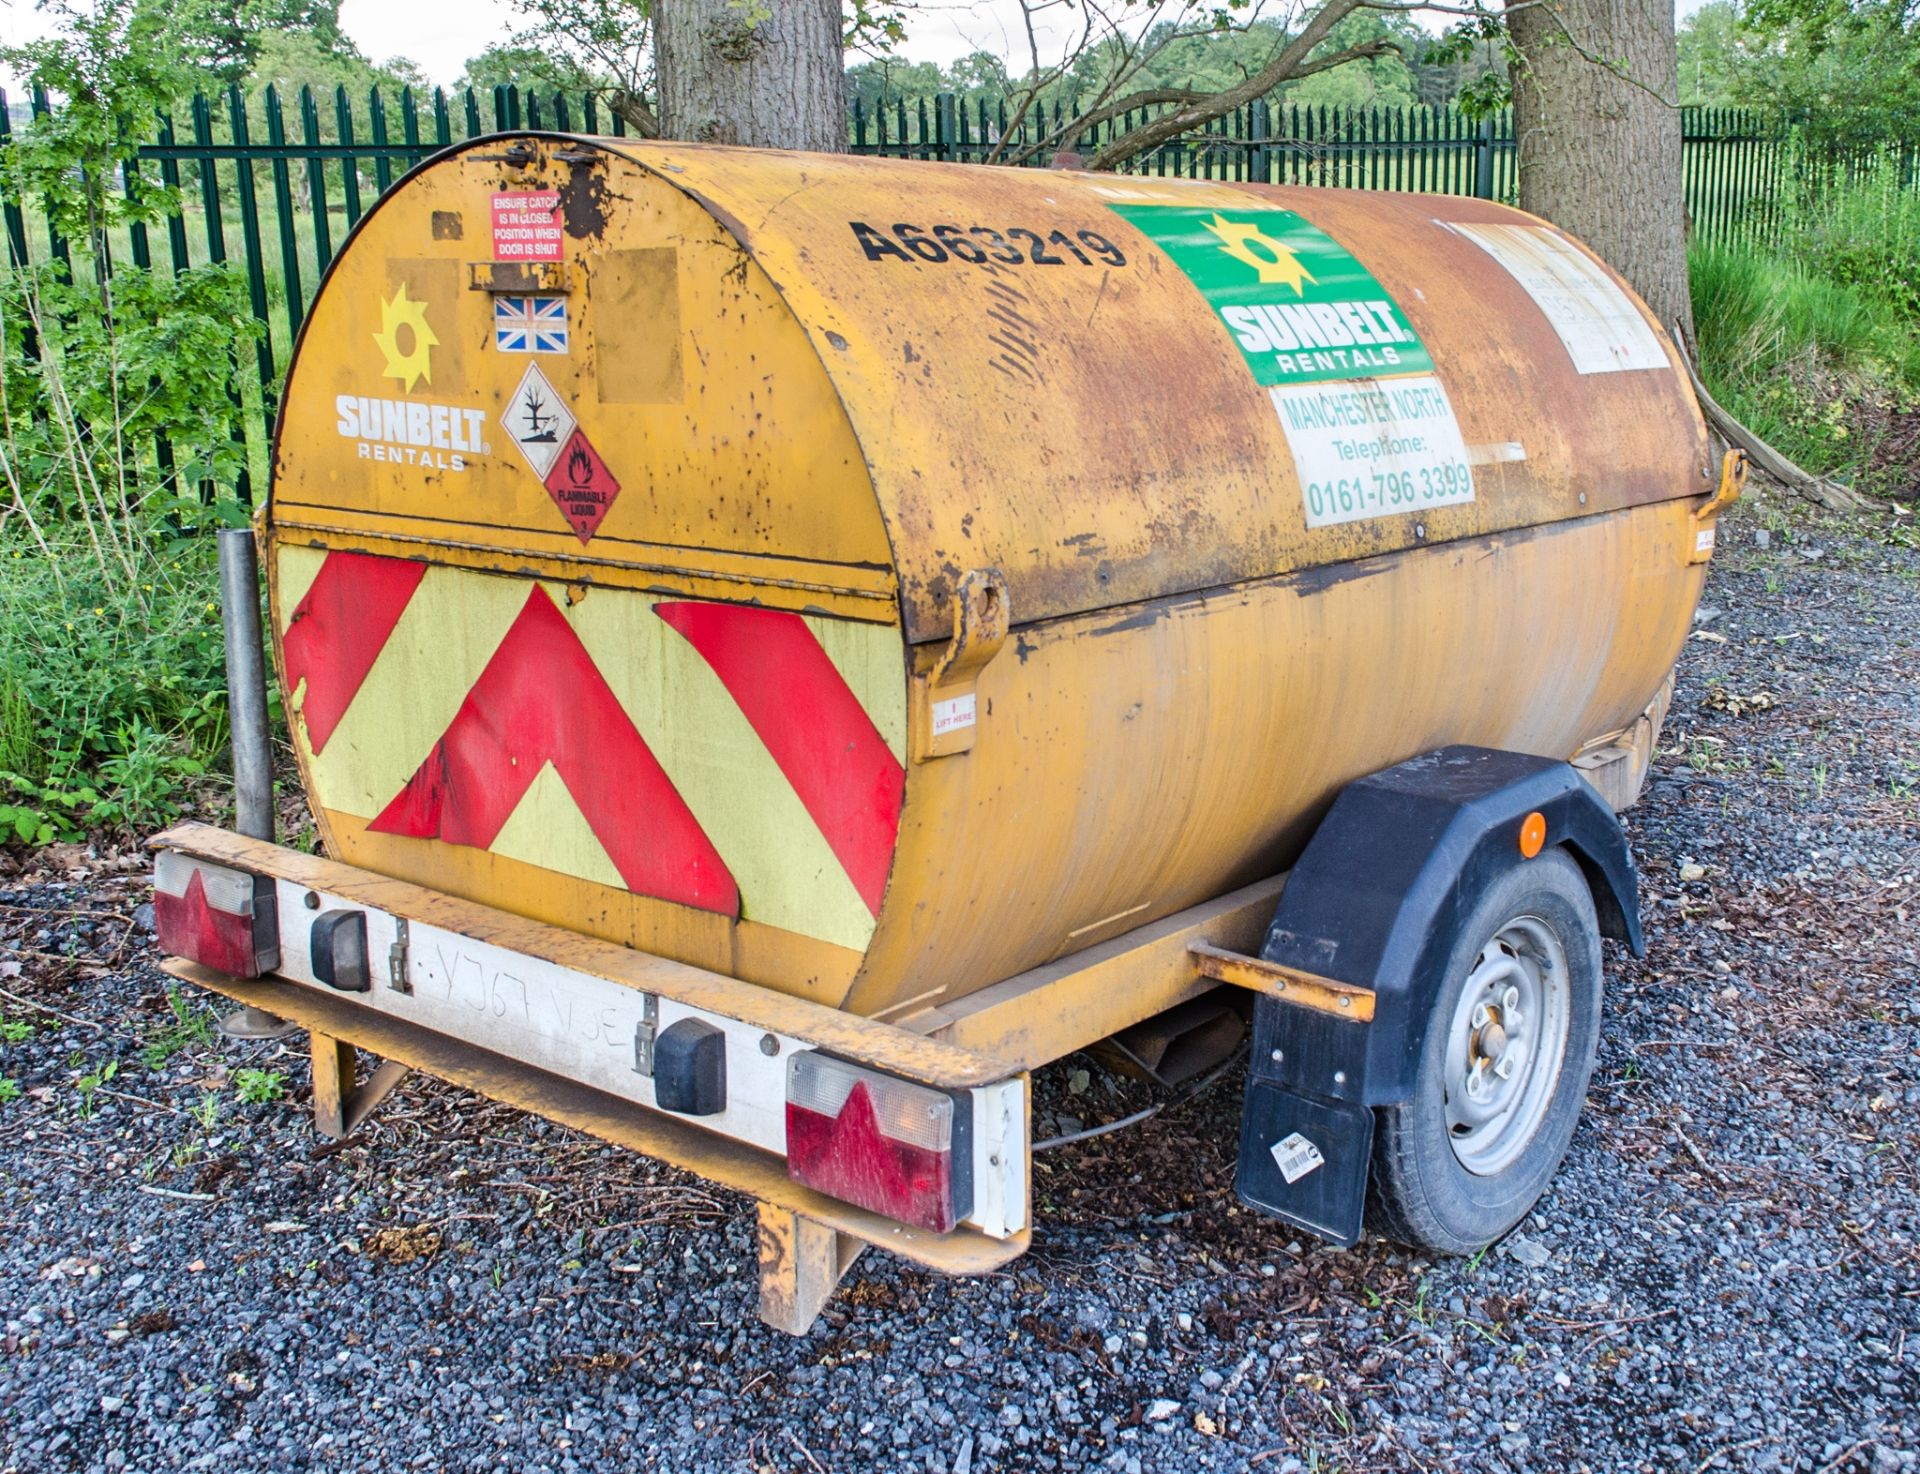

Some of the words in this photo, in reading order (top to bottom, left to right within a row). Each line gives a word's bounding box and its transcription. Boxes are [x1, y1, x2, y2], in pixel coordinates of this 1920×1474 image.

[494, 197, 528, 209] ENSURE
[528, 196, 558, 209] CATCH
[499, 213, 508, 224] IS
[509, 213, 519, 224] IN
[520, 212, 554, 224] CLOSED
[494, 228, 534, 240] POSITION
[534, 228, 561, 240] WHEN
[848, 221, 1127, 267] A663219
[498, 243, 524, 255] DOOR
[525, 243, 534, 255] IS
[534, 242, 558, 255] SHUT
[1220, 300, 1408, 353] SUNBELT
[1275, 347, 1401, 374] RENTALS
[1282, 391, 1398, 431] MANCHESTER
[1391, 387, 1449, 421] NORTH
[336, 394, 487, 454] SUNBELT
[358, 442, 465, 472] RENTALS
[1332, 435, 1428, 463] Telephone:
[558, 490, 606, 504] FLAMMABLE
[1307, 470, 1415, 517] 0161-796
[1419, 463, 1471, 500] 3399
[570, 503, 596, 516] LIQUID
[936, 717, 952, 728] LIFT
[953, 711, 973, 723] HERE
